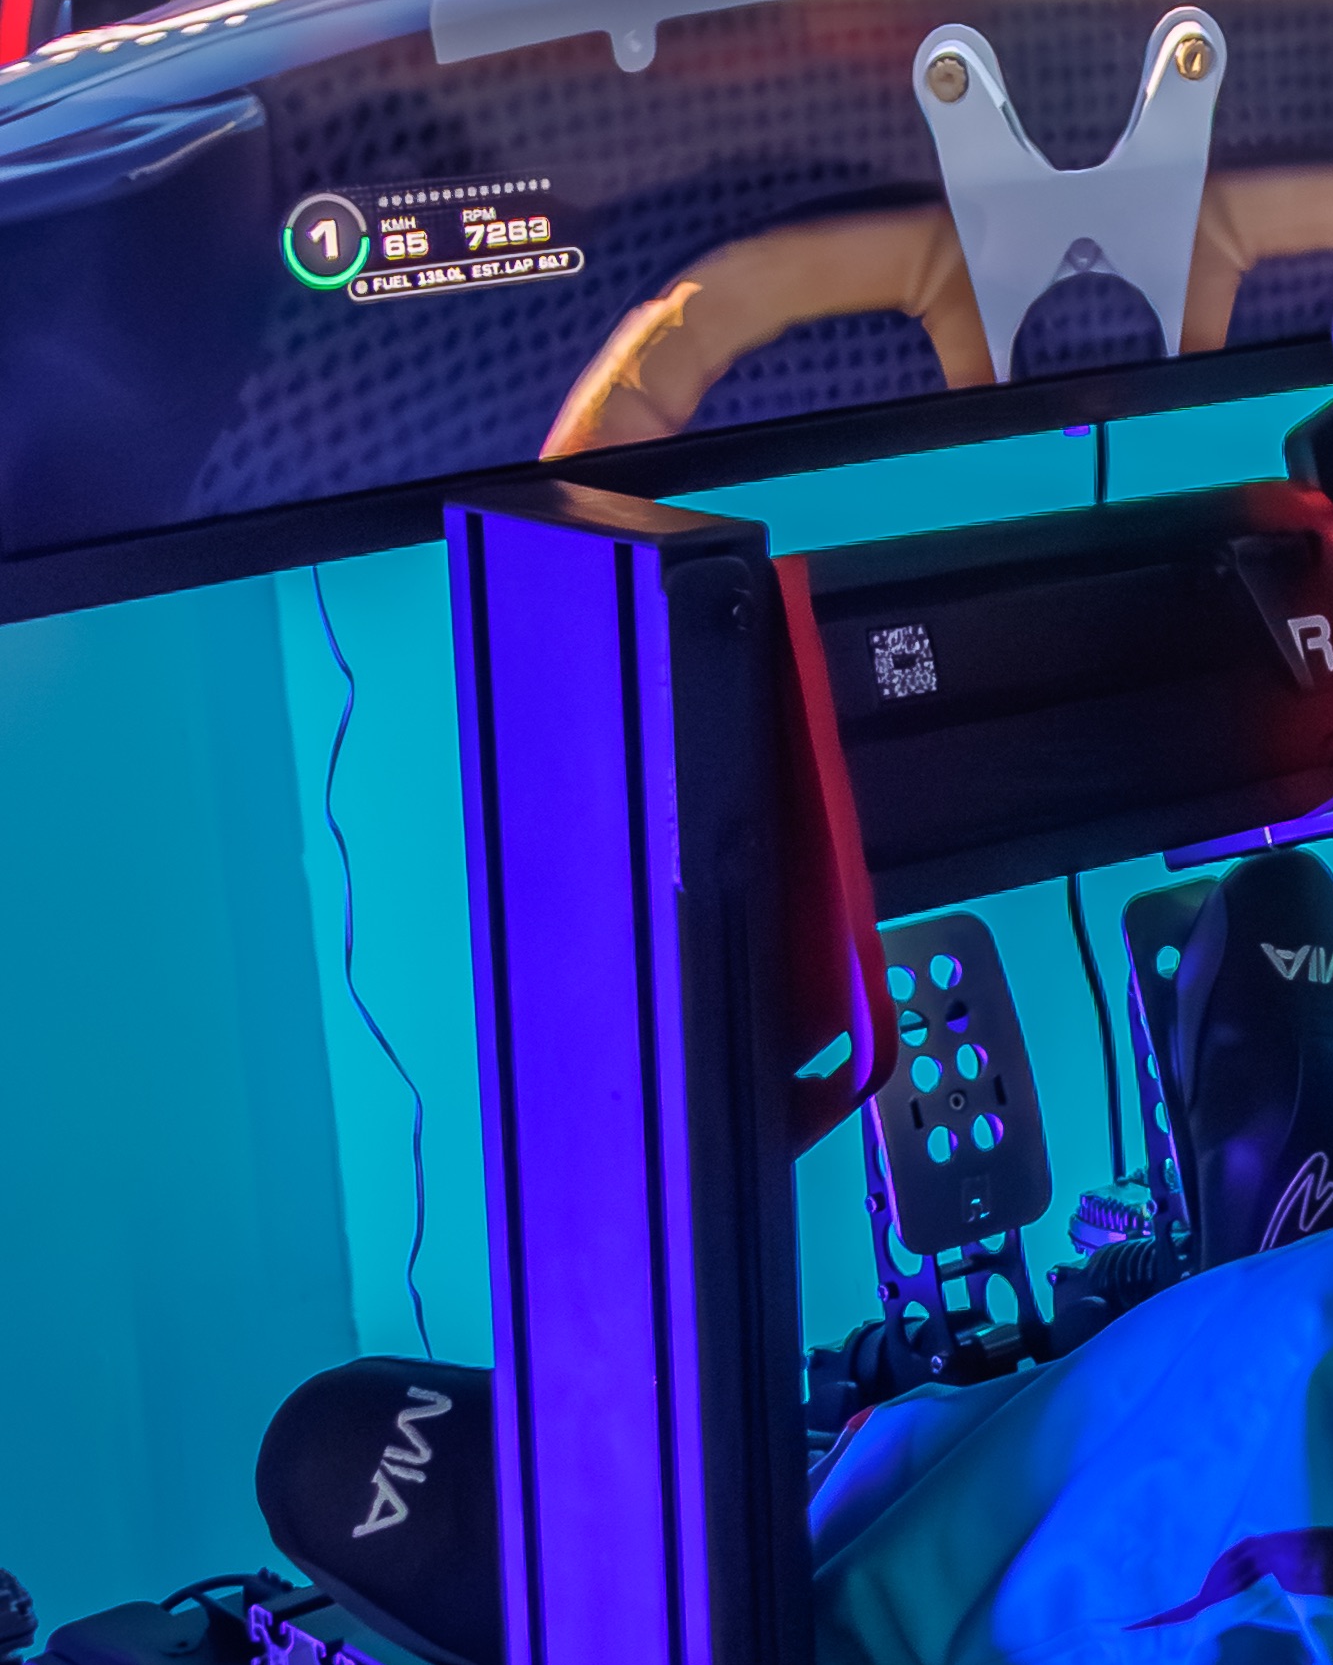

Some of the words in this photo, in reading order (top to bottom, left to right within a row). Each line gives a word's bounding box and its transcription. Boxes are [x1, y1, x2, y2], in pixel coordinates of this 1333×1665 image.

[379, 216, 417, 234] KMH
[461, 206, 497, 223] RPM
[308, 218, 339, 261] 1
[383, 231, 428, 260] 65
[352, 1386, 453, 1539] MIA
